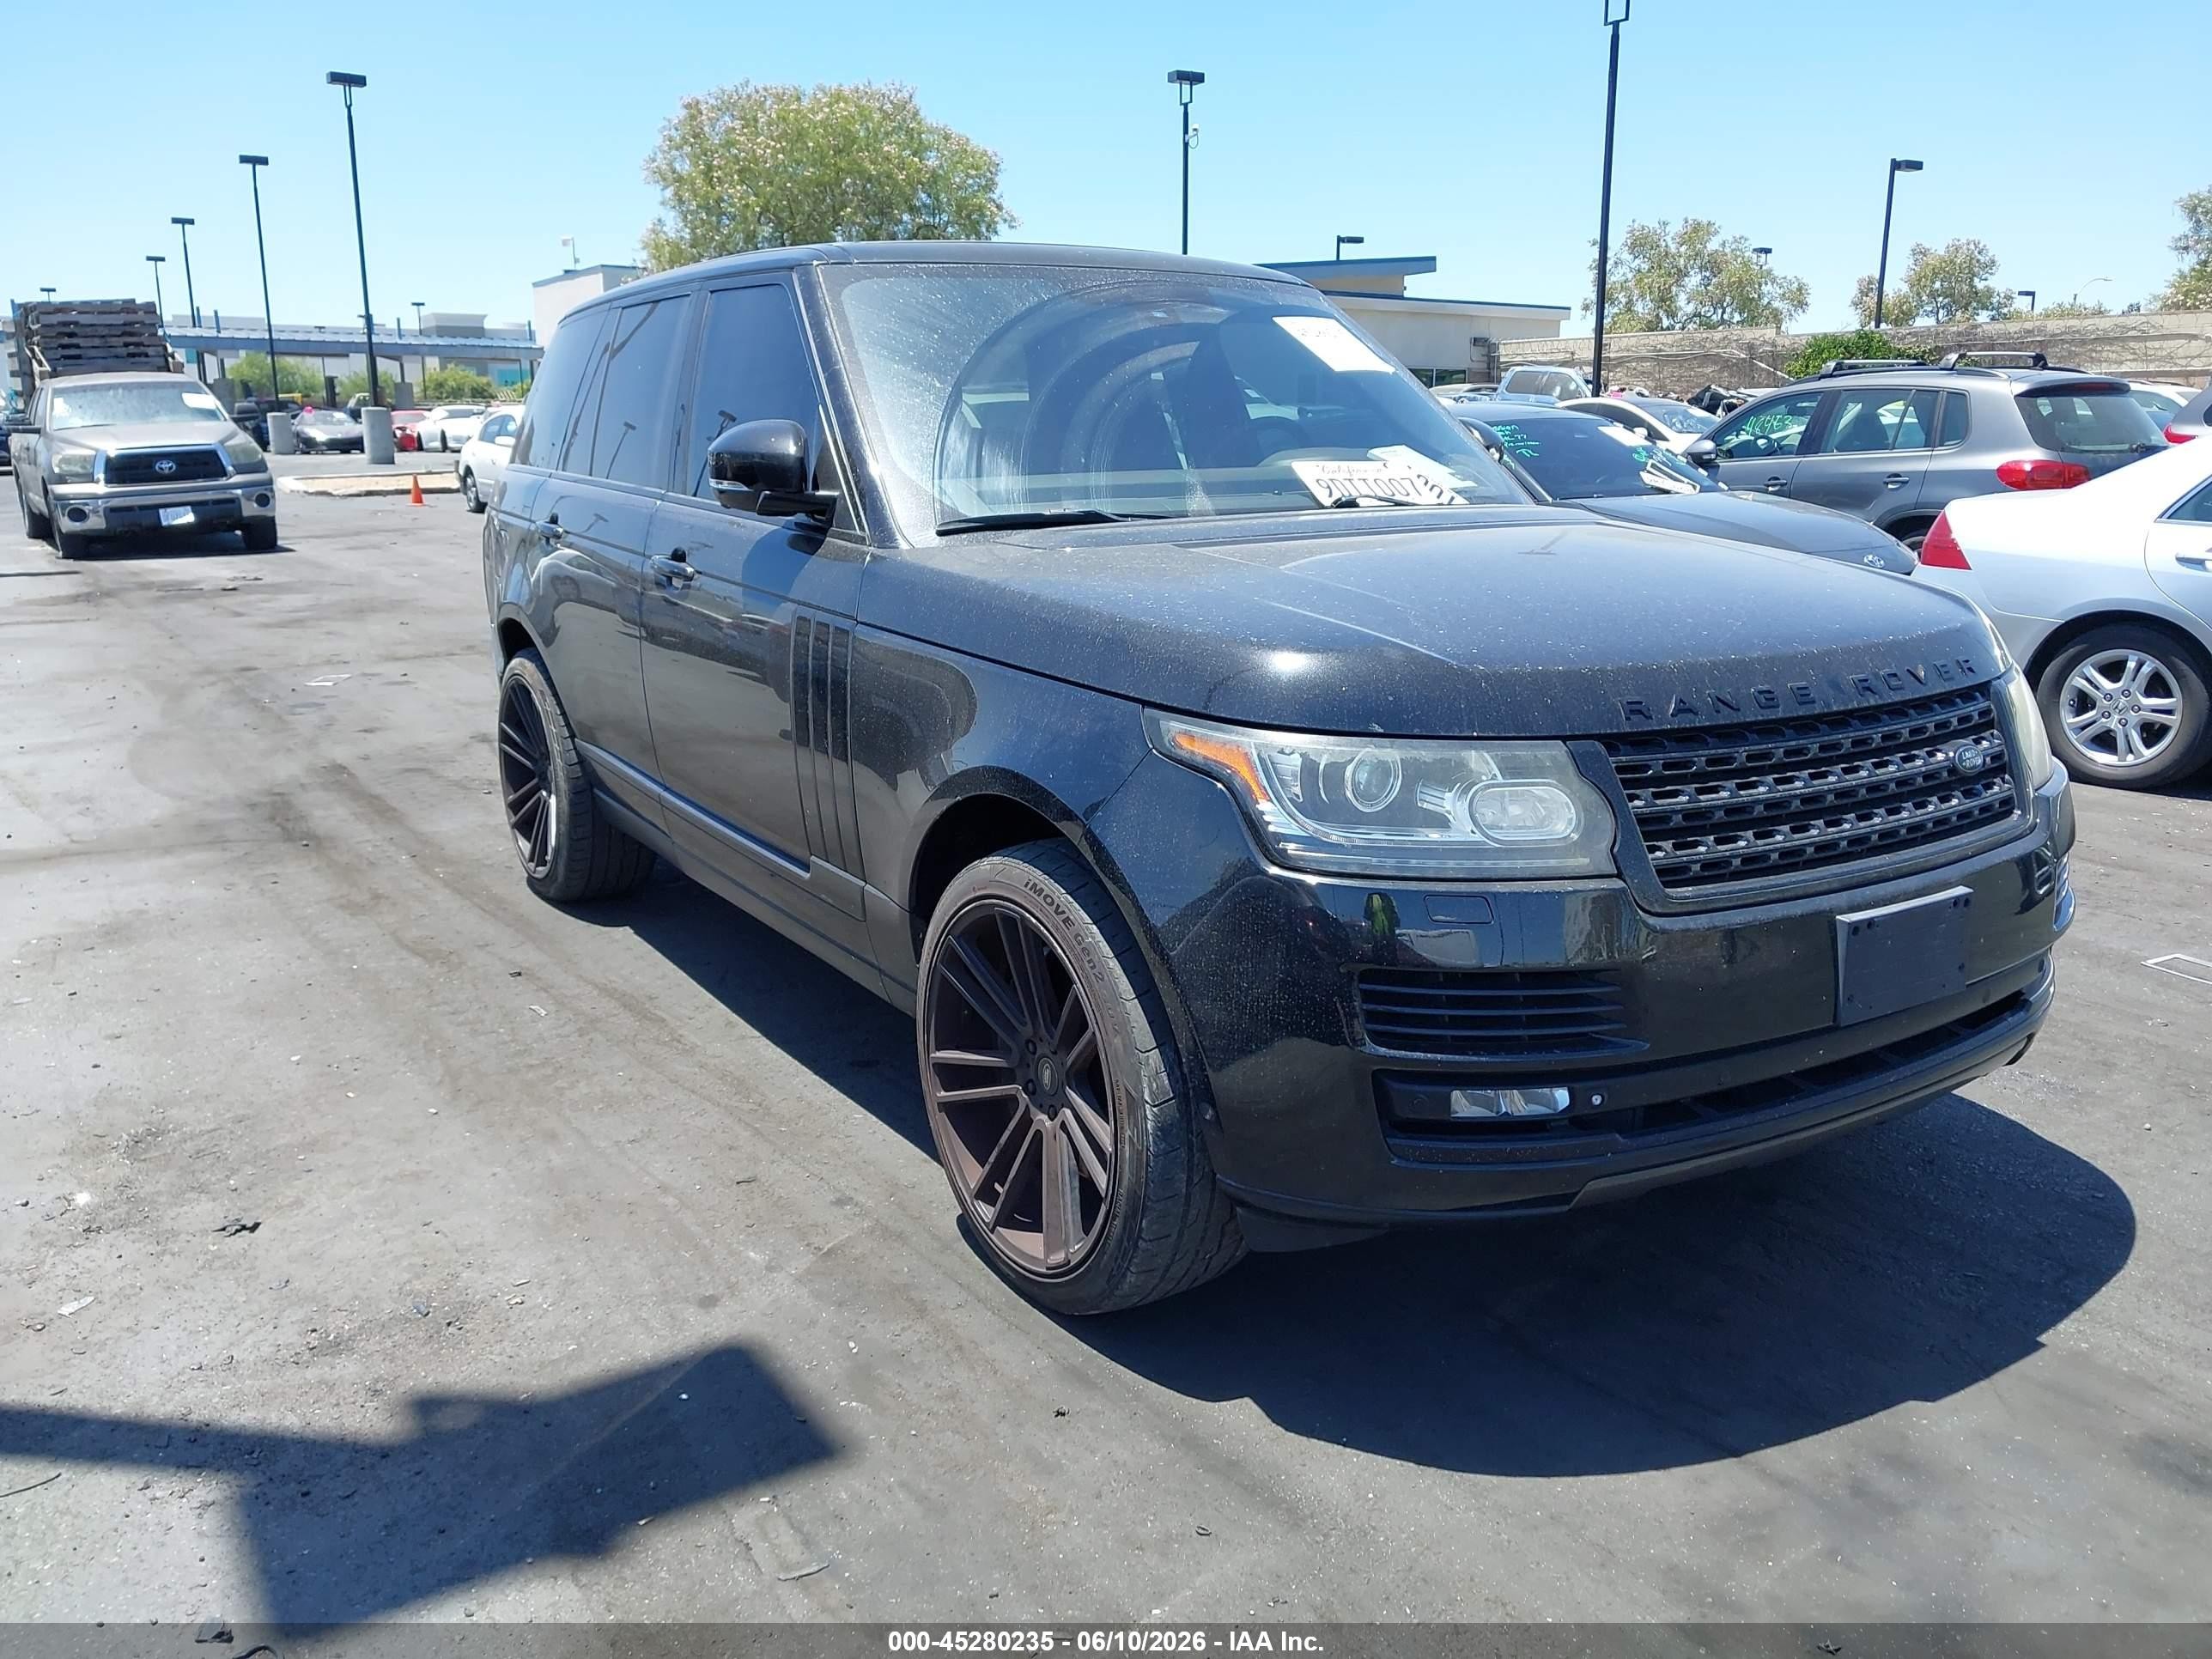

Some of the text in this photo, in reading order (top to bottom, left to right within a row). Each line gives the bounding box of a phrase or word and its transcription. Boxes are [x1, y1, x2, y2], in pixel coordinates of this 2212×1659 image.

[1618, 658, 1976, 721] RANGE ROVER
[1962, 749, 1977, 760] LAND
[1024, 878, 1076, 931] iMOVE
[1073, 933, 1105, 984] Gen2
